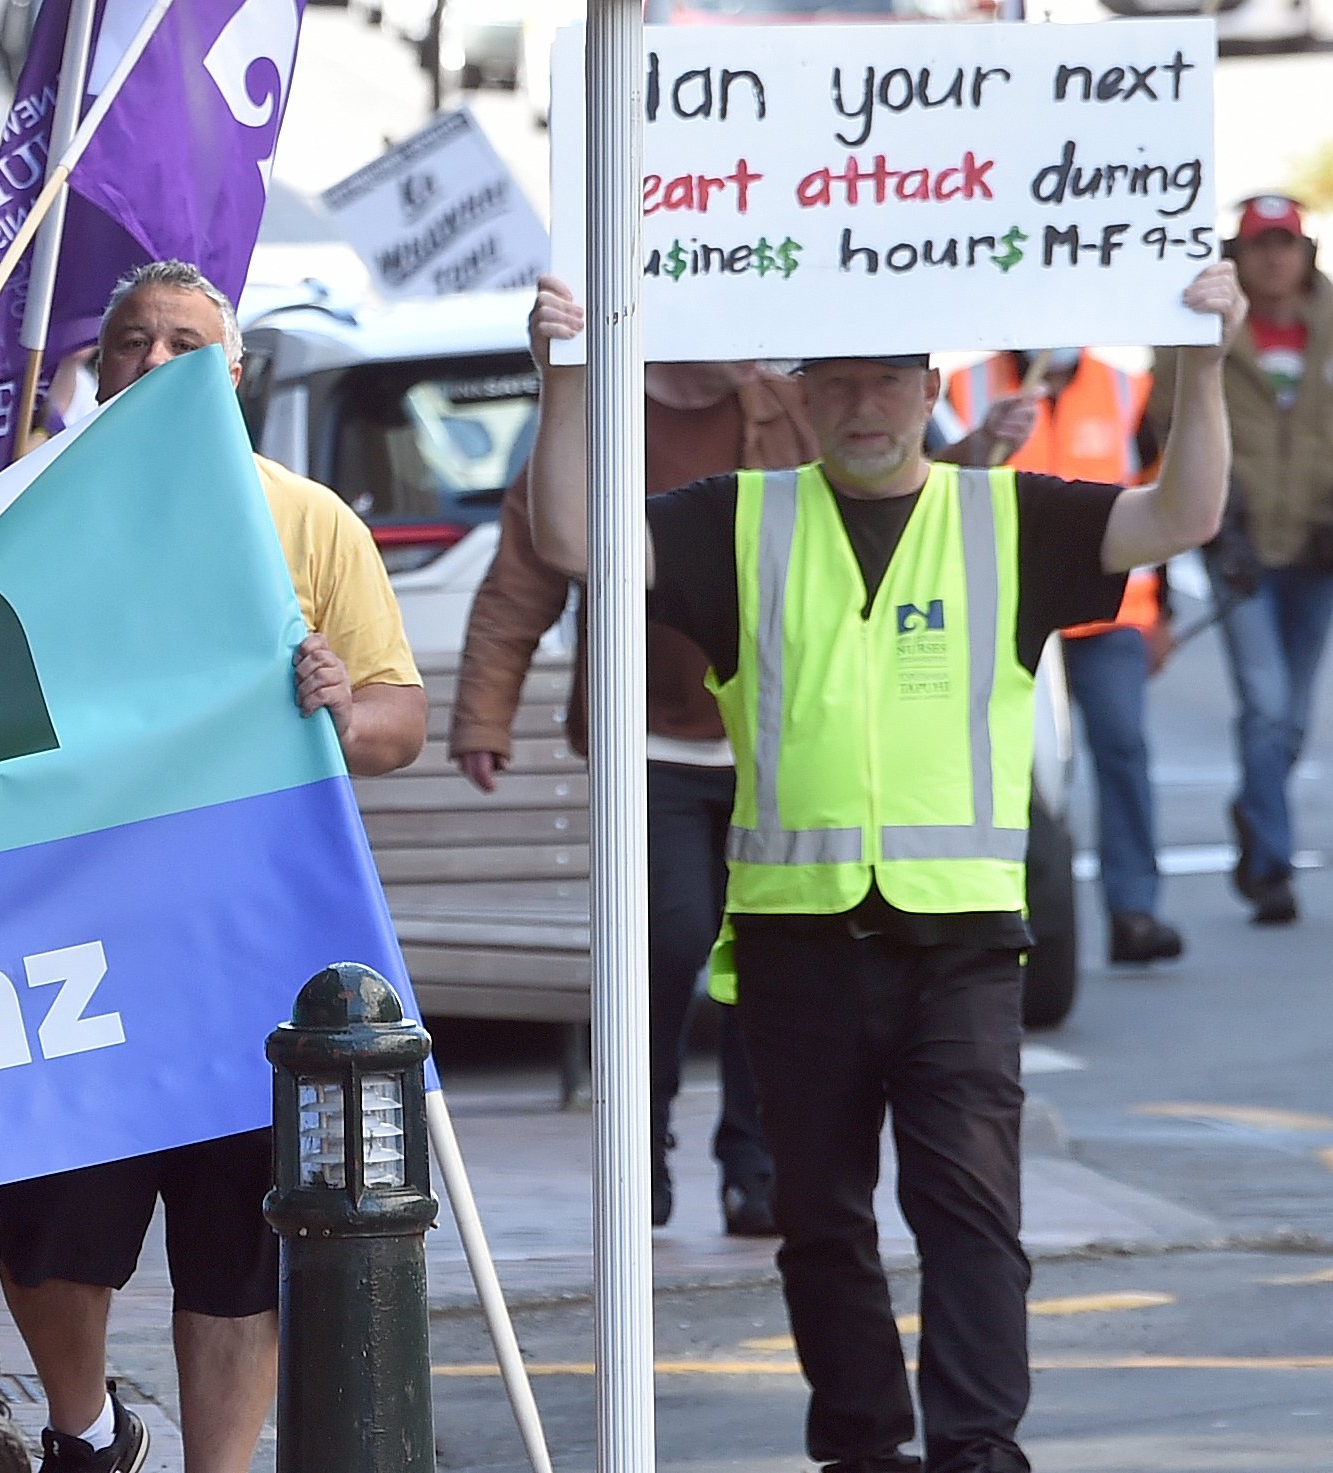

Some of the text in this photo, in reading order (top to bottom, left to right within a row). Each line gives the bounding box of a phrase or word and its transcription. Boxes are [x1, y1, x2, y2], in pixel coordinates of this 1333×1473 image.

[832, 65, 1011, 147] your
[1053, 51, 1195, 101] next
[796, 151, 995, 208] attack
[1031, 140, 1202, 217] during
[840, 225, 1029, 274] hour$
[1042, 223, 1132, 267] M-F
[1140, 225, 1215, 261] 9-5
